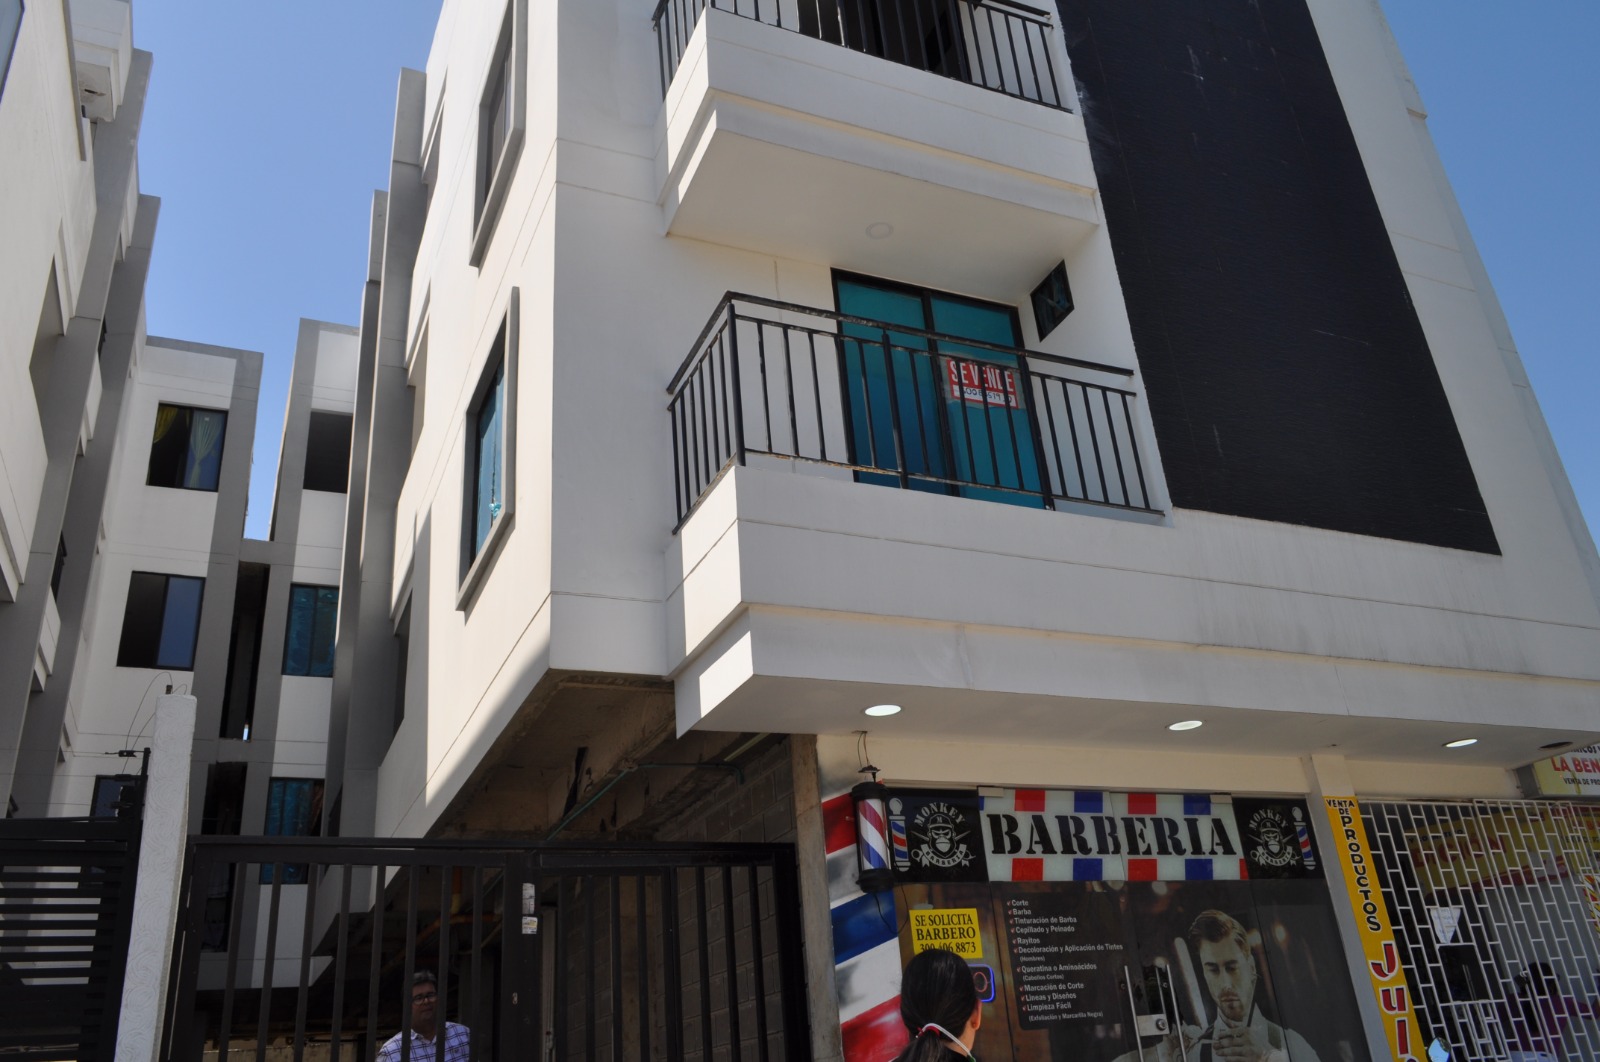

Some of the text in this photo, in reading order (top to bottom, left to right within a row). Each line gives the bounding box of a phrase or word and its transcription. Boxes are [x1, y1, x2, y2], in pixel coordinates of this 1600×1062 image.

[949, 361, 969, 384] SE
[1551, 756, 1571, 772] LA
[1326, 798, 1356, 808] VENTA
[914, 802, 966, 827] MONKEY
[1337, 807, 1351, 816] DE
[1248, 808, 1289, 831] MONKEY
[986, 813, 1237, 857] BARBERIA
[1340, 814, 1382, 933] PRODUCTOS
[1011, 899, 1029, 907] Corte
[1012, 908, 1032, 916] Barba
[915, 913, 974, 927] SE SOLICITA
[1059, 916, 1078, 924] Barba
[916, 927, 977, 941] BARBERO
[1015, 926, 1045, 935] Cepillado
[1050, 925, 1076, 933] Peinado
[1016, 937, 1041, 946] Rayitos
[955, 941, 977, 954] 8873
[1018, 945, 1059, 954] Decoloración
[1064, 943, 1096, 953] Aplicación
[1096, 943, 1105, 951] de
[1105, 943, 1124, 951] Tintes
[1021, 964, 1052, 974] Queratina
[1024, 981, 1085, 992] Marcación de Corte
[1052, 991, 1077, 1000] Diseños
[1026, 1003, 1055, 1012] Limpieza
